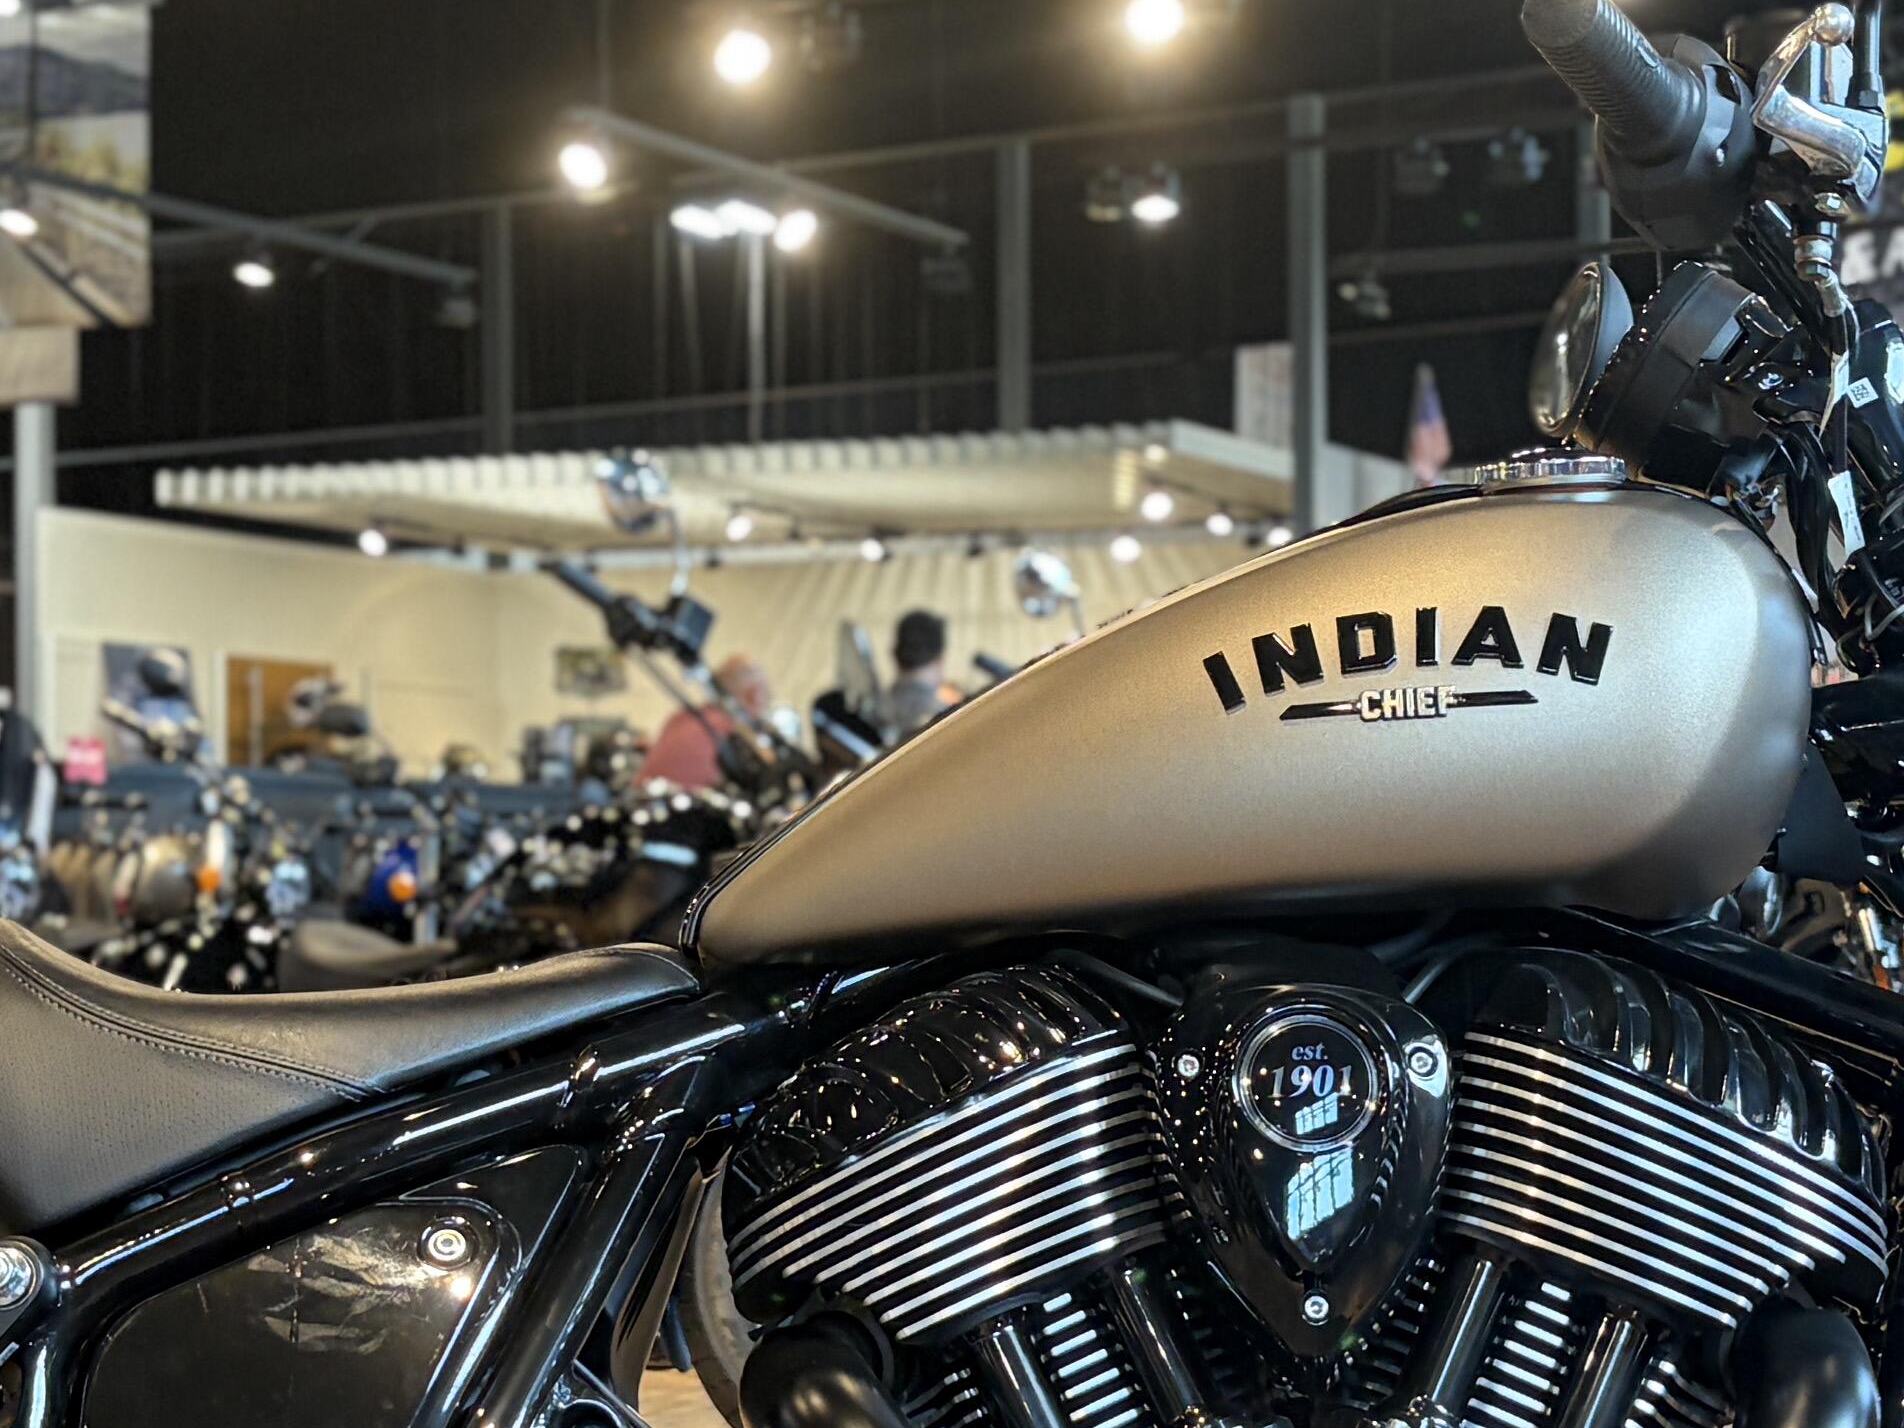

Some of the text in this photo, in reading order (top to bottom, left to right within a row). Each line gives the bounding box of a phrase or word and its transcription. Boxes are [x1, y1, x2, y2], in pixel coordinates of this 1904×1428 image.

[1202, 605, 1614, 715] INDIAN
[1359, 685, 1457, 722] CHIEF
[1290, 1042, 1329, 1062] est.
[1267, 1063, 1355, 1099] 1901
